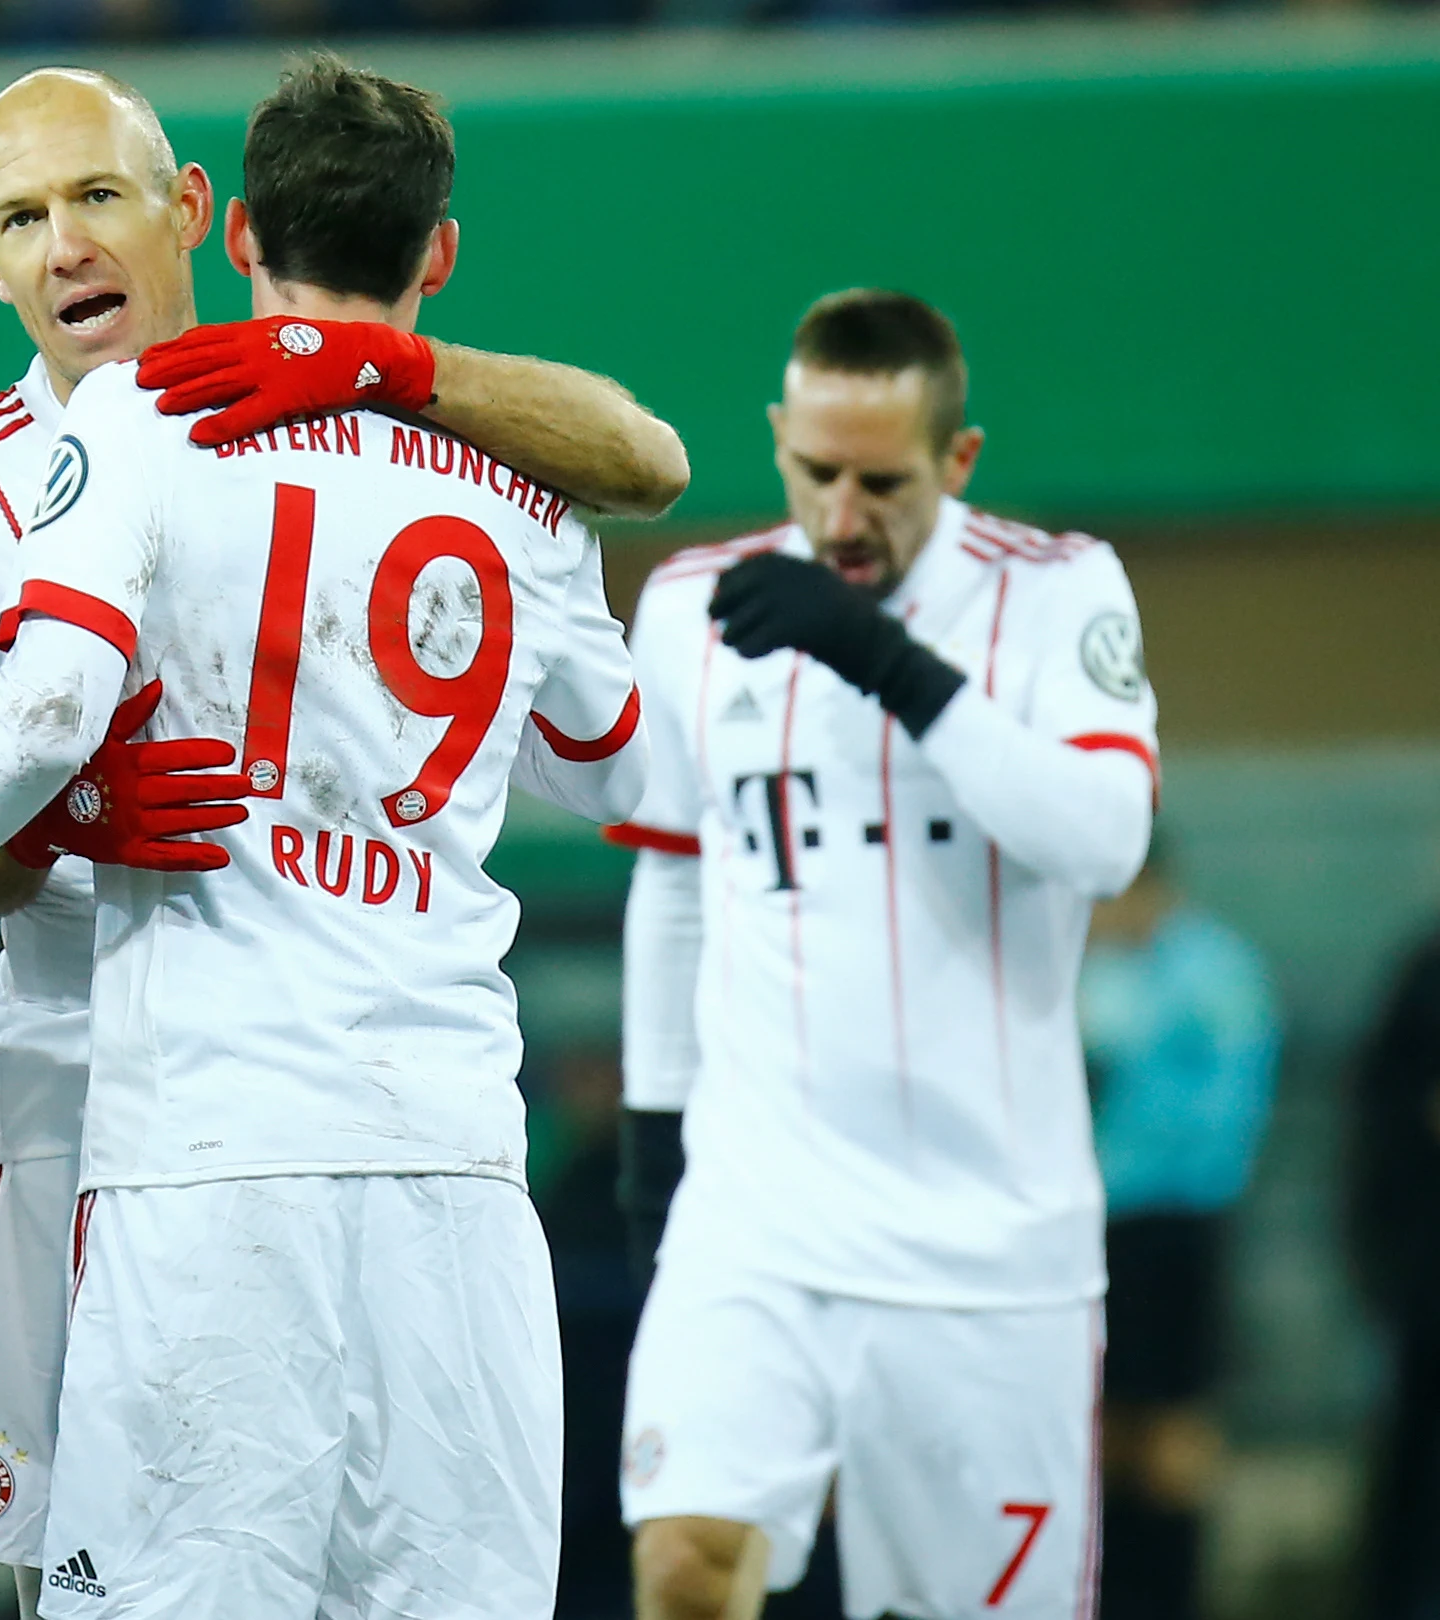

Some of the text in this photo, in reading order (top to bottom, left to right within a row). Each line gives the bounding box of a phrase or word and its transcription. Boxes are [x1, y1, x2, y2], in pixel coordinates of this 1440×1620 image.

[242, 481, 514, 829] 19
[270, 824, 435, 914] RUDY
[732, 766, 818, 892] T
[49, 1573, 106, 1598] adidas
[986, 1503, 1056, 1609] 7
